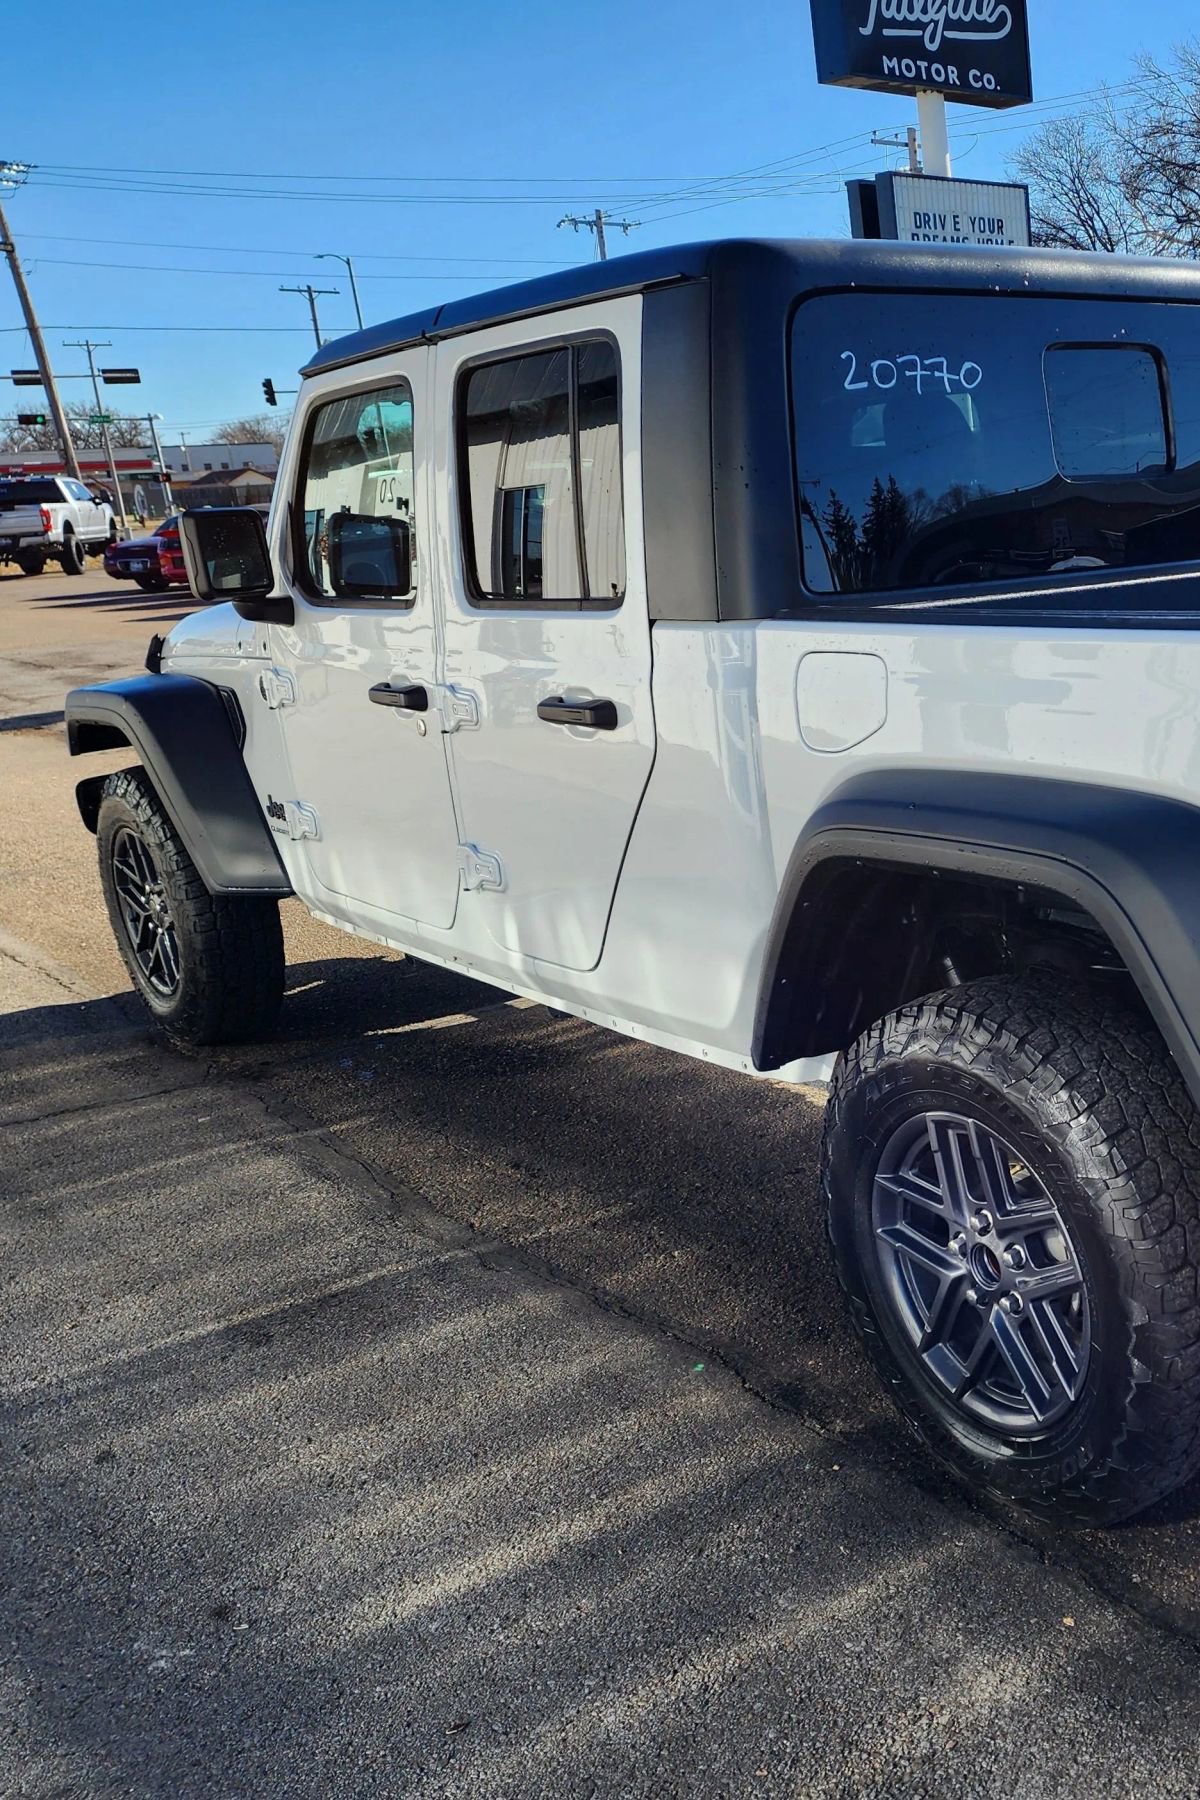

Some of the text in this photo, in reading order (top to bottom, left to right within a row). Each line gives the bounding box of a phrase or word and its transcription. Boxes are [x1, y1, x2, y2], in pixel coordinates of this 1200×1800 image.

[882, 55, 1001, 91] MOTOR CO.
[969, 216, 1004, 236] YOUR
[840, 351, 983, 395] 20770
[266, 794, 287, 821] Jee
